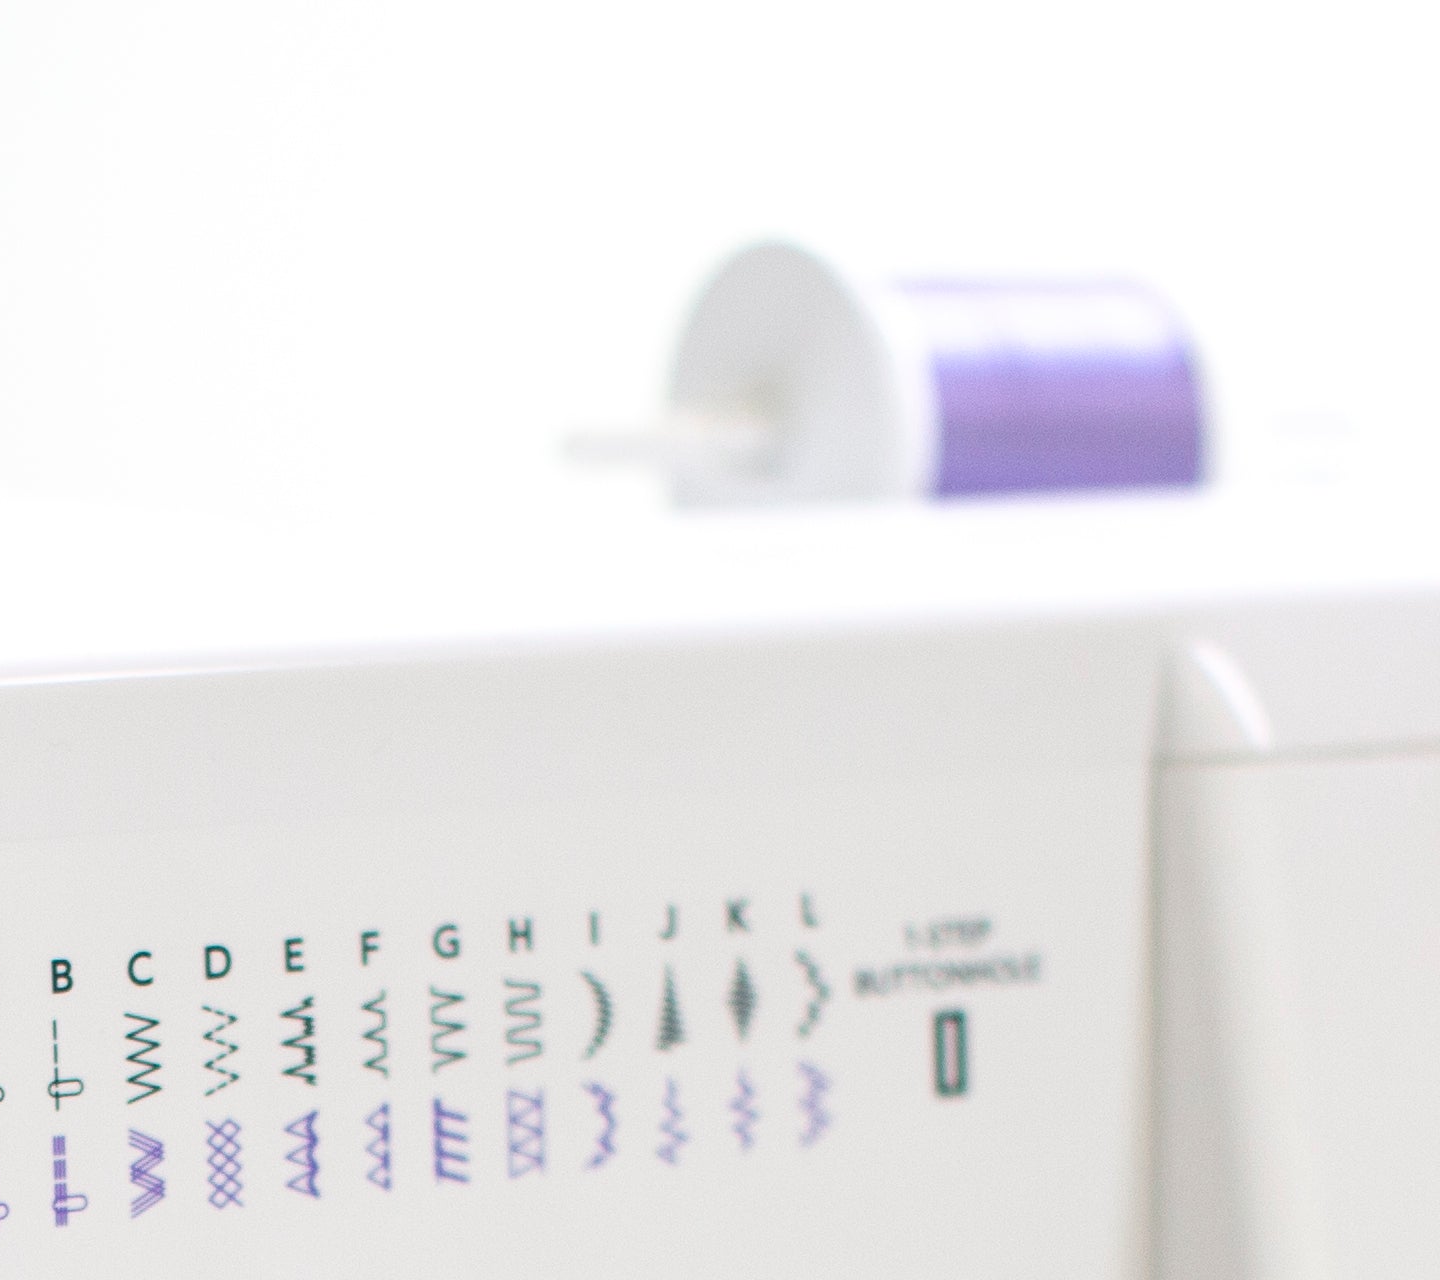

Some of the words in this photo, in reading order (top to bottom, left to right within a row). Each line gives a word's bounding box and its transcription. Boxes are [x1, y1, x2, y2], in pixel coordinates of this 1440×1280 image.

[49, 958, 75, 995] B
[126, 950, 155, 987] C
[202, 944, 234, 981] D
[283, 936, 305, 974] E
[358, 930, 381, 967] F
[431, 922, 462, 961] G
[507, 917, 534, 953] H
[587, 911, 601, 947] I
[659, 904, 679, 942] J
[725, 898, 750, 932] K
[798, 891, 823, 931] L
